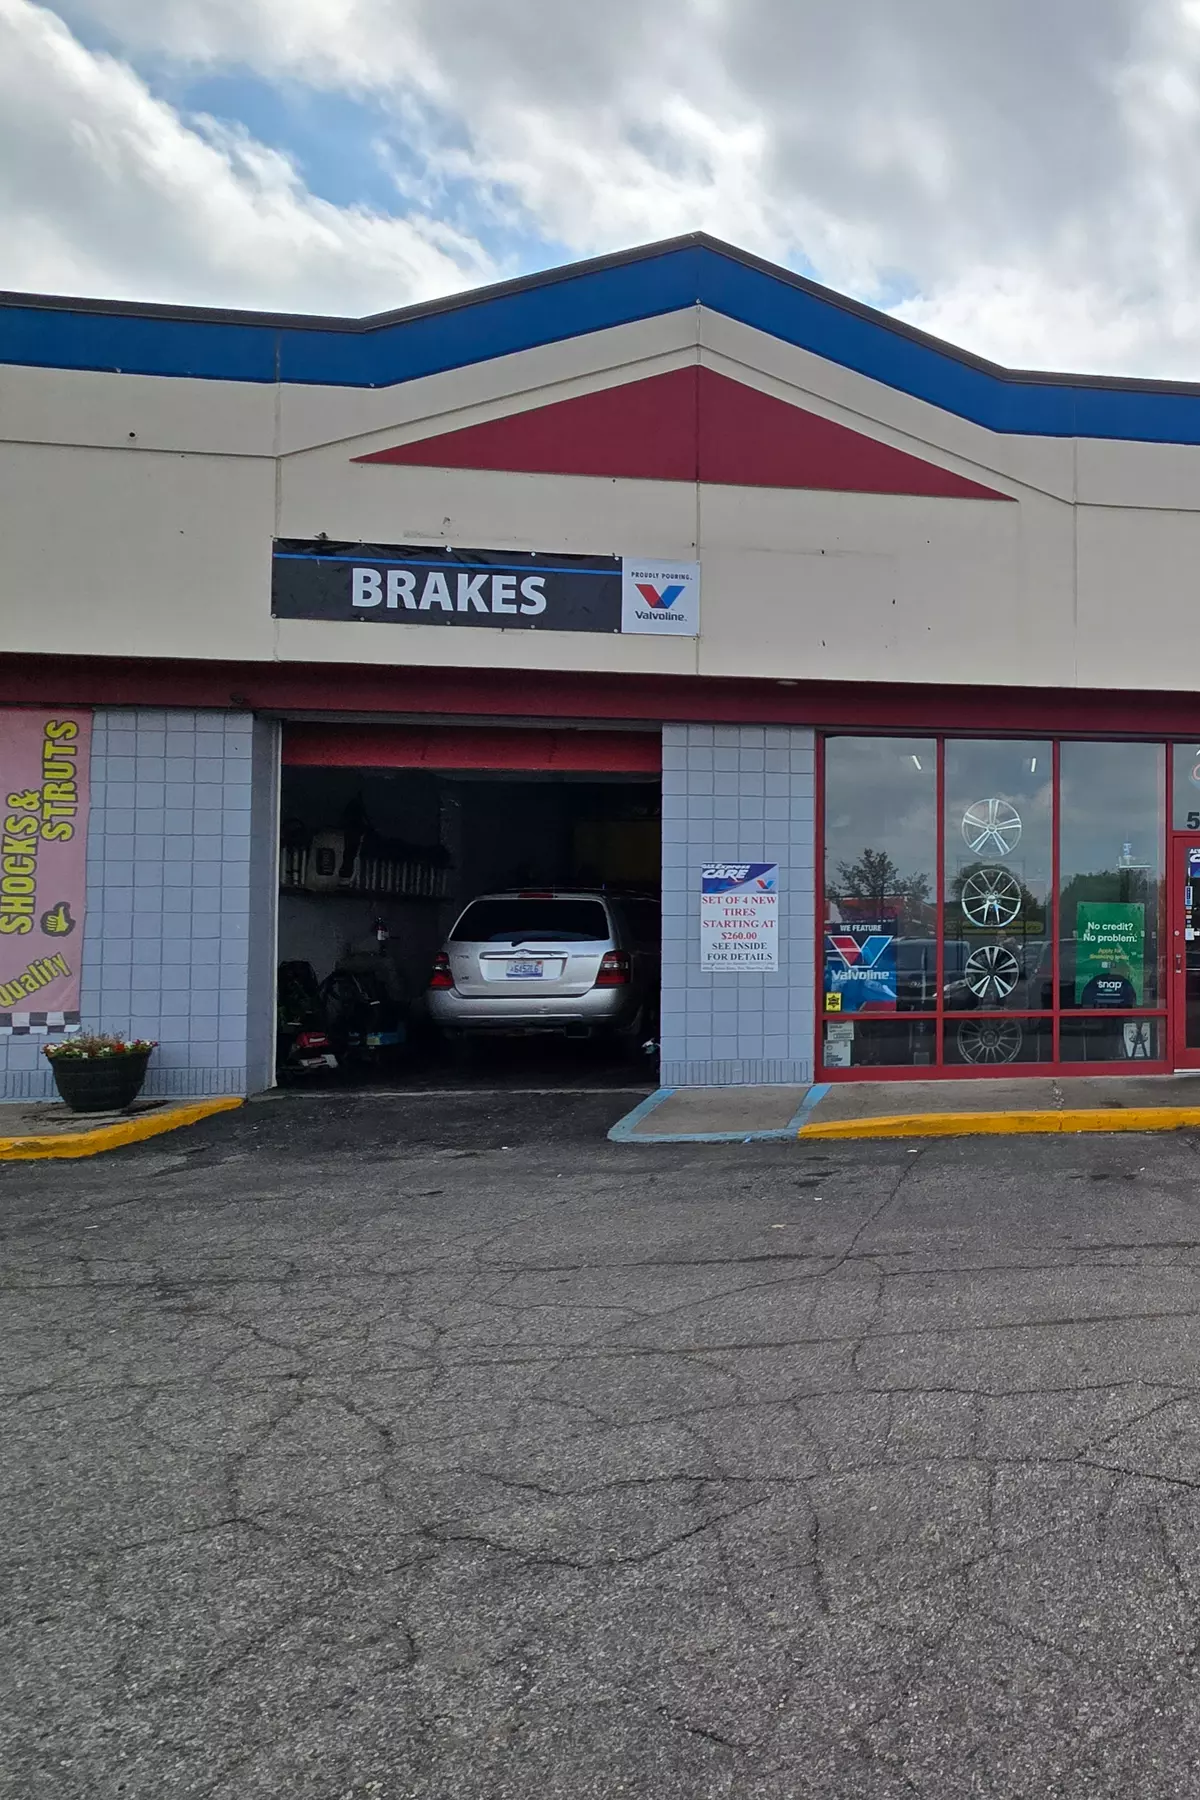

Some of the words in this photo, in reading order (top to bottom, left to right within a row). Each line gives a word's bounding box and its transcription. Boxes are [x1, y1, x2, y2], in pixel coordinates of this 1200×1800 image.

[631, 571, 659, 579] PROUDLY
[351, 568, 547, 615] BRAKES
[41, 720, 78, 842] STRUTS
[7, 789, 41, 812] &
[0, 815, 40, 935] SHOCKS
[702, 869, 749, 882] CARE
[702, 896, 722, 904] SET
[725, 896, 740, 904] OF
[742, 896, 749, 905] 4
[751, 896, 777, 904] NEW
[723, 908, 756, 916] TIRES
[702, 920, 759, 929] STARTING
[760, 920, 776, 928] AT
[840, 924, 851, 932] WE
[852, 924, 882, 932] FEATURE
[1087, 921, 1100, 930] No
[1101, 922, 1134, 931] credit?
[721, 932, 757, 941] $260.00
[1083, 932, 1096, 942] No
[712, 942, 731, 950] SEE
[733, 942, 768, 950] INSIDE
[707, 953, 728, 961] FOR
[730, 953, 773, 961] DETAILS
[831, 969, 891, 980] Valvoline
[1098, 980, 1122, 991] snap
